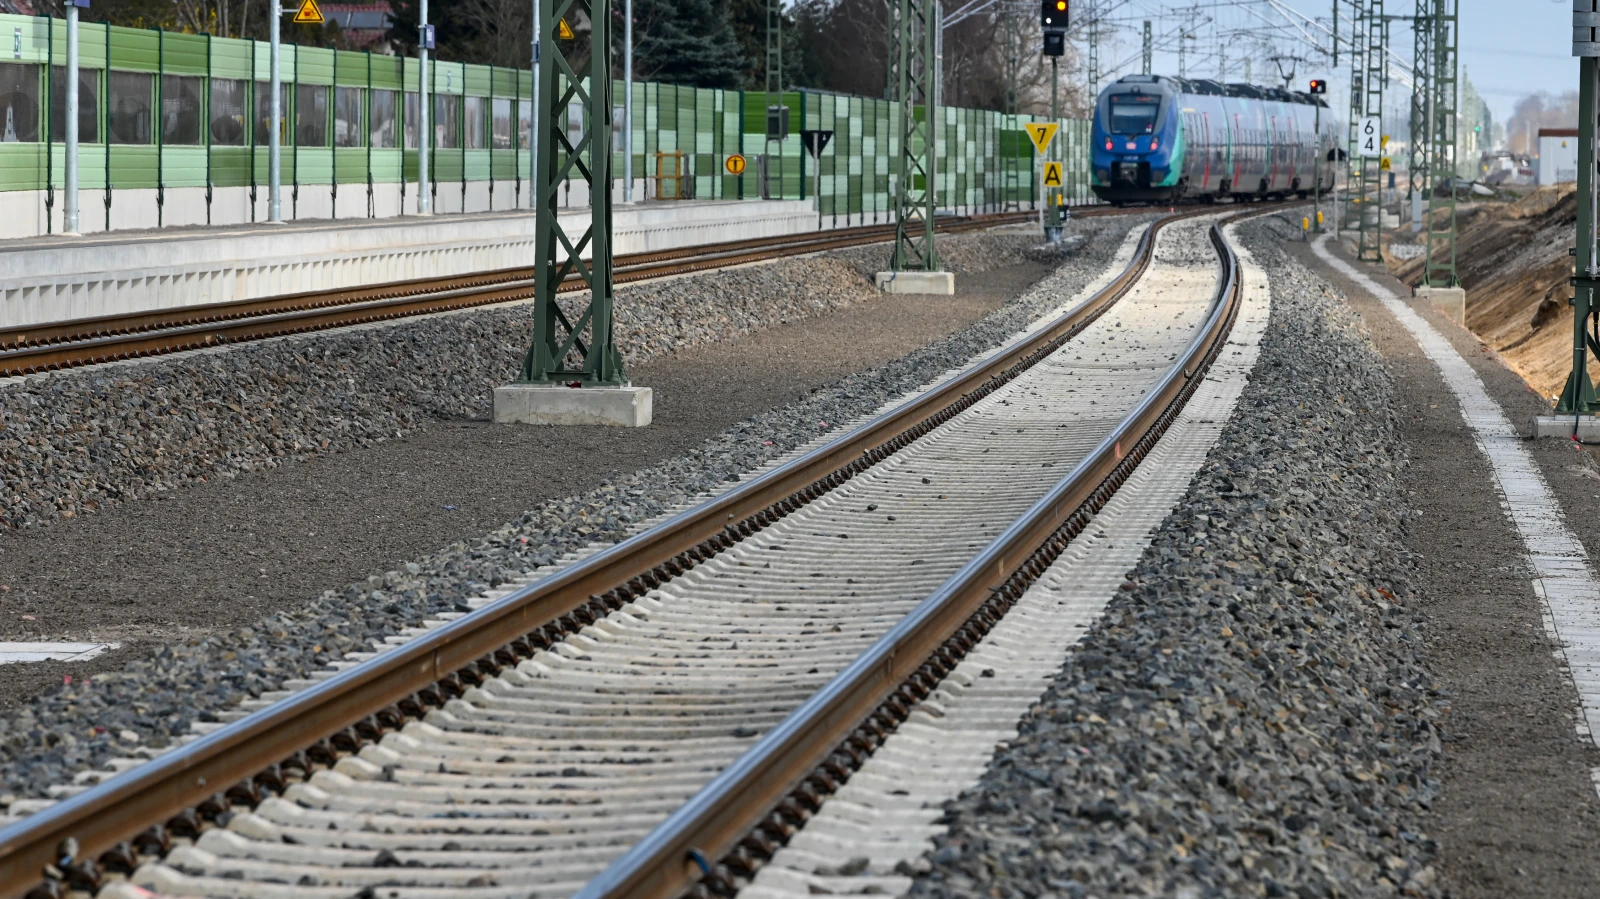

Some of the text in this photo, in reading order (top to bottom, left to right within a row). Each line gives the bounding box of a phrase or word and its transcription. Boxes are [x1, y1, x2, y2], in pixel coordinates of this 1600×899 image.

[1364, 119, 1374, 135] 6
[1037, 127, 1047, 144] 7
[1364, 136, 1374, 151] 4
[1381, 158, 1390, 168] A
[1044, 164, 1061, 185] A
